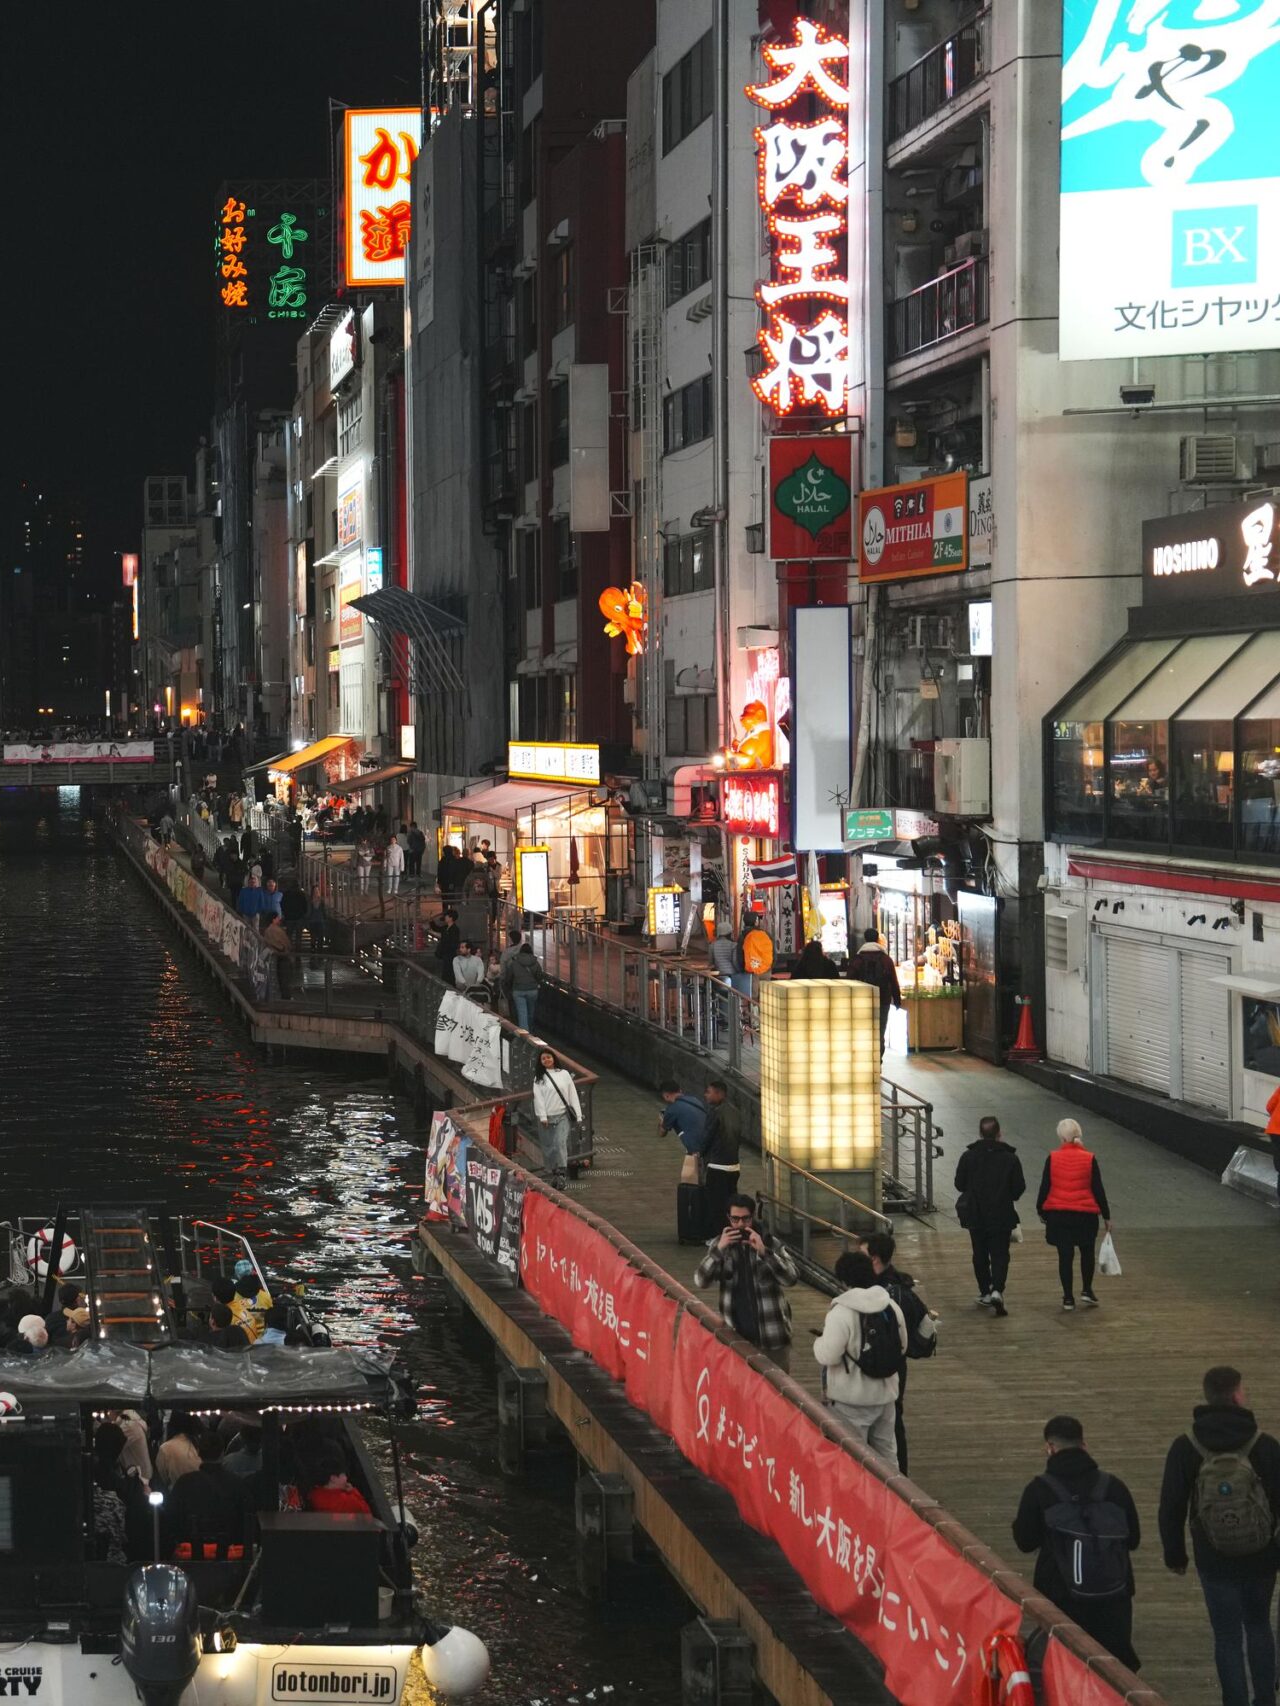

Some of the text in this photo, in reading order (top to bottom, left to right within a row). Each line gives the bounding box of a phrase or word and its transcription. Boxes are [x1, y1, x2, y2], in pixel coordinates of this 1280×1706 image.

[744, 15, 850, 417] 大阪王将
[220, 198, 248, 306] お好み焼
[1183, 225, 1248, 267] BX
[267, 213, 308, 308] 千房
[267, 310, 306, 319] CHIBO
[792, 483, 832, 505] حلال
[796, 504, 830, 514] HALAL
[885, 521, 932, 545] MITHILA
[1152, 537, 1219, 576] HOSHINO
[151, 1634, 176, 1643] 130
[4, 1666, 43, 1676] CRUISE
[276, 1669, 391, 1698] dotonbori.jp
